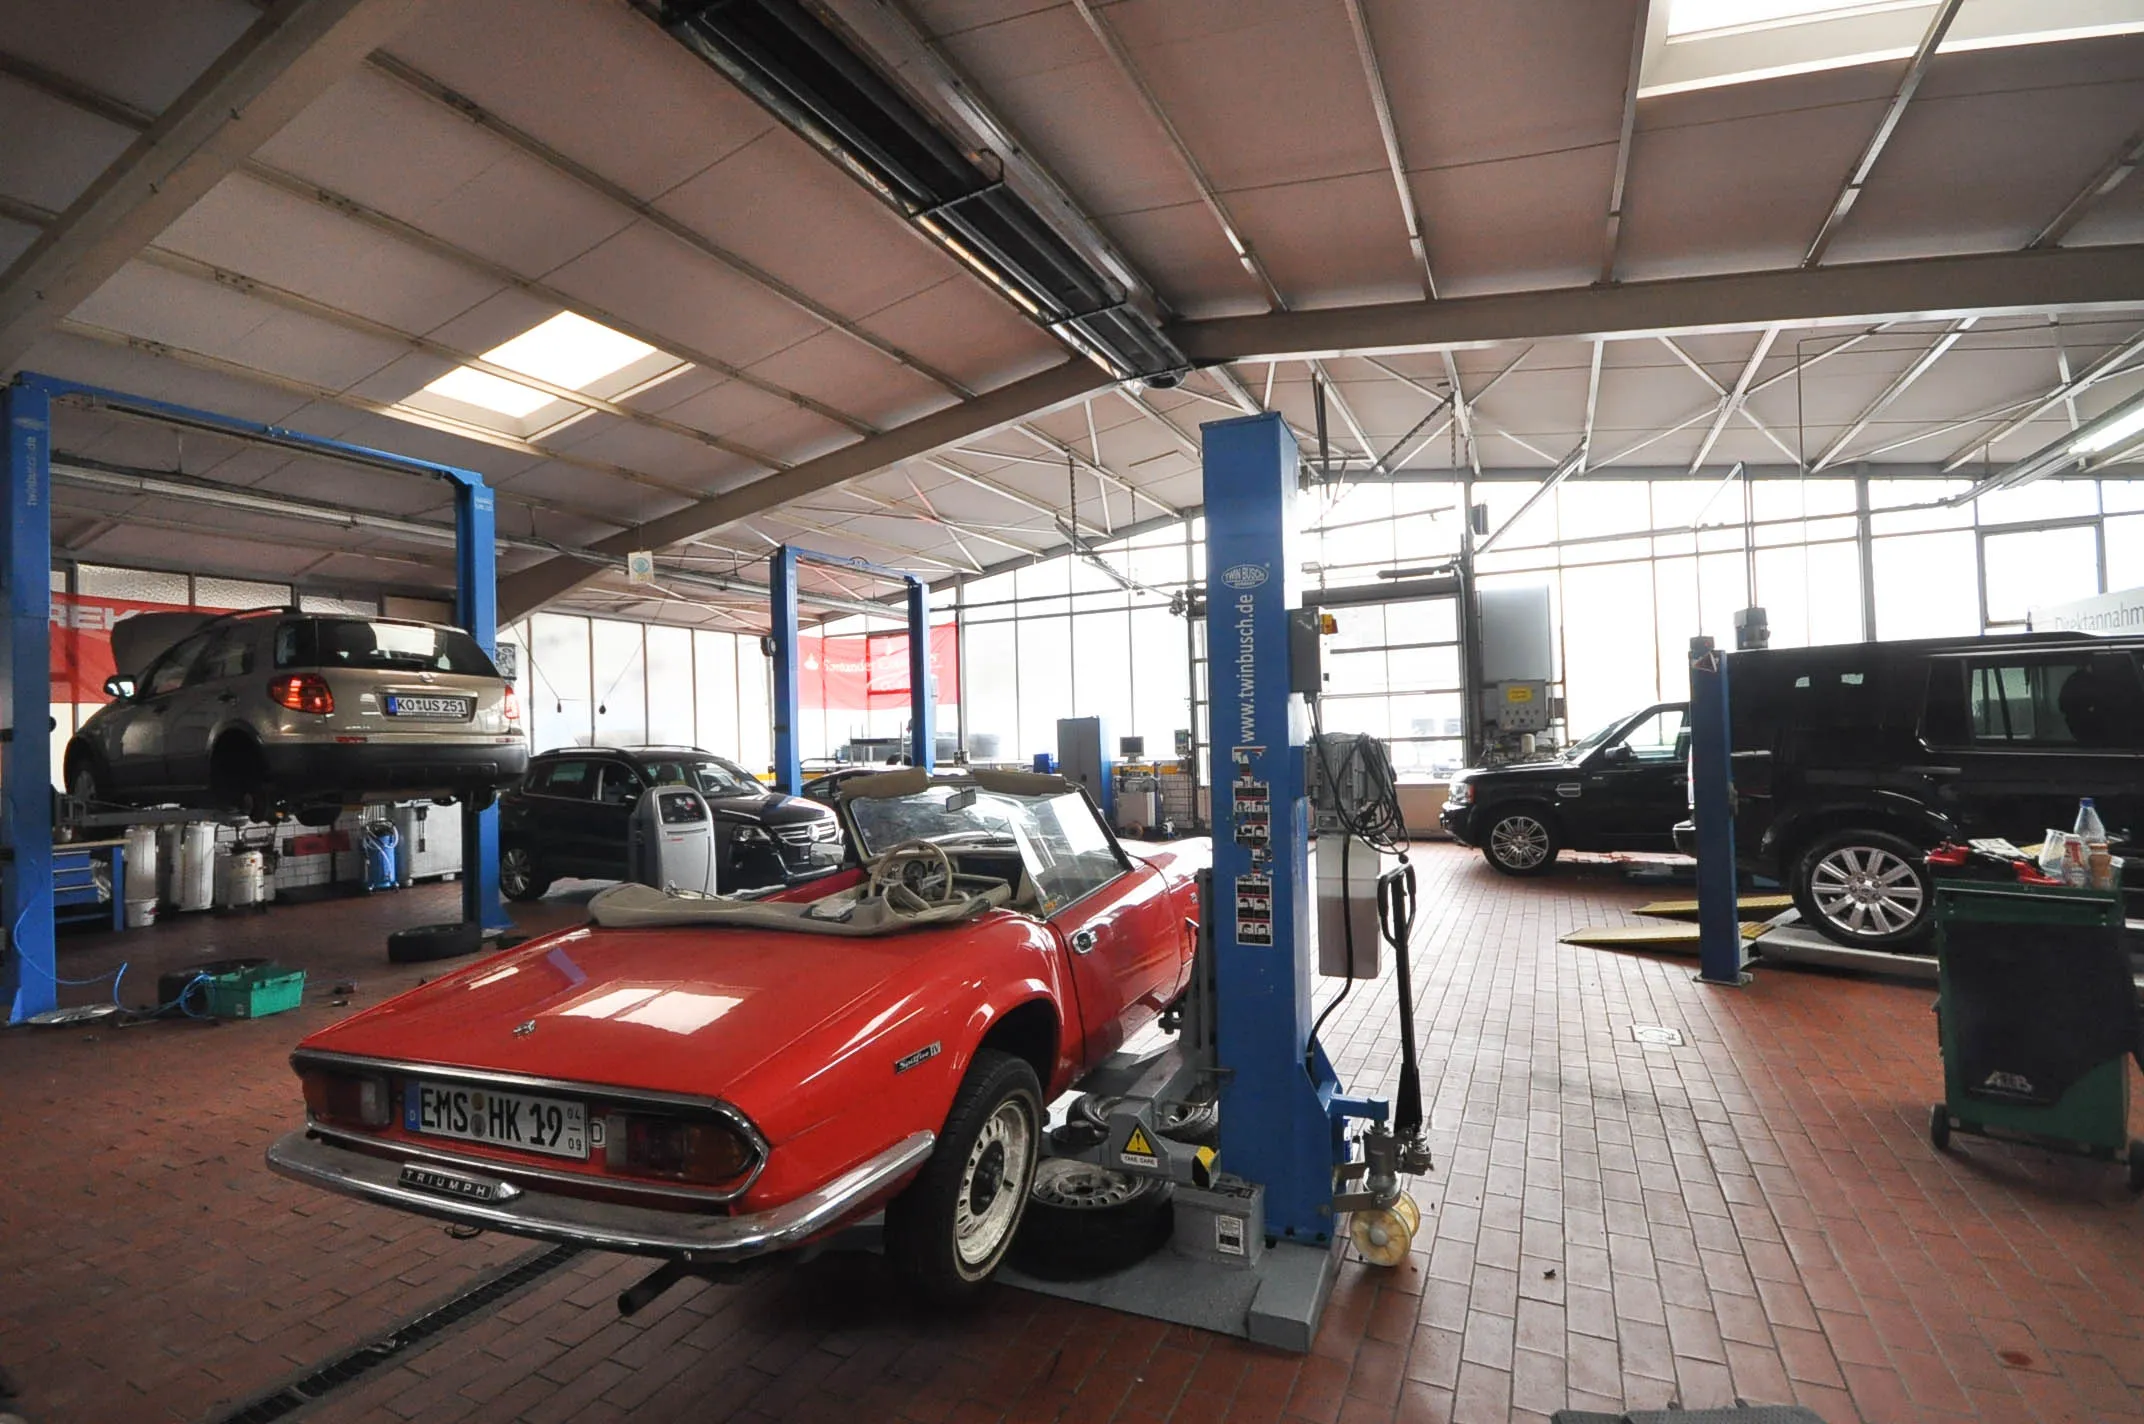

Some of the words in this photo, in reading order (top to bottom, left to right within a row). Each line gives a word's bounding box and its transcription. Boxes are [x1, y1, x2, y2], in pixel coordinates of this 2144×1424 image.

[1234, 593, 1255, 743] www.twinbusch.de
[396, 698, 415, 711] KO
[424, 700, 440, 712] US
[443, 700, 465, 713] 251
[420, 1088, 468, 1133] EMS
[488, 1096, 522, 1142] HK
[529, 1103, 563, 1147] 19
[567, 1107, 581, 1121] 04
[567, 1138, 582, 1151] 09
[405, 1169, 486, 1197] TRIUMPH
